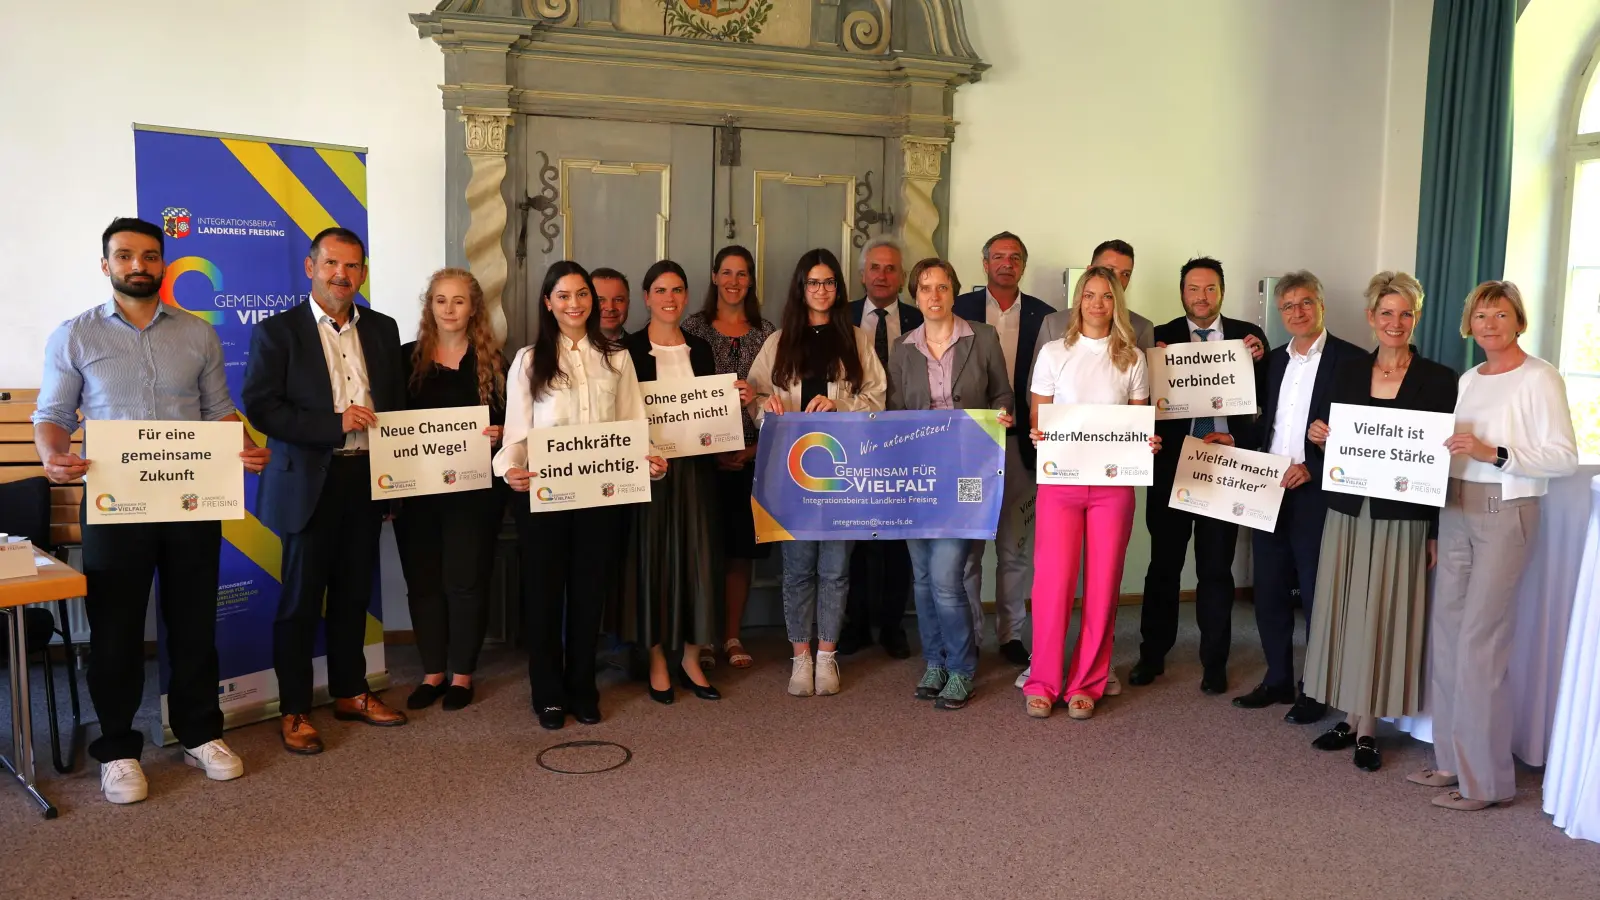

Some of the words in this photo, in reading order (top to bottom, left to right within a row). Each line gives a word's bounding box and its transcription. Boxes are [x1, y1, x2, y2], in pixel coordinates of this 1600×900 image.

[197, 217, 277, 228] INTEGRATIONSBEIRAT
[197, 226, 247, 236] LANDKREIS
[248, 227, 286, 237] FREISING
[214, 294, 296, 308] GEMEINSAM
[1164, 349, 1236, 366] Handwerk
[1168, 373, 1236, 388] verbindet
[644, 394, 677, 406] Ohne
[680, 389, 708, 404] geht
[711, 388, 725, 397] es
[648, 410, 690, 425] einfach
[693, 405, 728, 419] nicht!
[138, 428, 161, 440] Für
[165, 428, 195, 440] eine
[380, 426, 415, 438] Neue
[419, 420, 477, 434] Chancen
[860, 439, 879, 456] Wir
[883, 416, 952, 448] unterstützen!
[1042, 430, 1148, 443] #derMenschzählt
[1353, 421, 1404, 438] Vielfalt
[1407, 426, 1425, 440] ist
[393, 444, 419, 458] und
[422, 440, 467, 456] Wege!
[547, 433, 631, 453] Fachkräfte
[121, 449, 212, 464] gemeinsame
[1339, 445, 1386, 459] unsere
[1389, 448, 1435, 465] Stärke
[540, 462, 573, 479] sind
[577, 458, 639, 475] wichtig.
[834, 465, 908, 477] GEMEINSAM
[912, 464, 937, 476] FÜR
[1188, 450, 1238, 469] „Vielfalt
[1240, 463, 1279, 479] macht
[139, 469, 195, 482] Zukunft
[1192, 471, 1214, 483] uns
[1216, 476, 1267, 493] stärker“
[853, 477, 937, 493] VIELFALT
[1410, 485, 1441, 494] FREISING
[201, 500, 238, 508] FREISING
[802, 496, 869, 506] Integrationsbeirat
[870, 496, 907, 505] Landkreis
[908, 495, 938, 505] Freising
[832, 518, 913, 527] integration@kreis-fs.de
